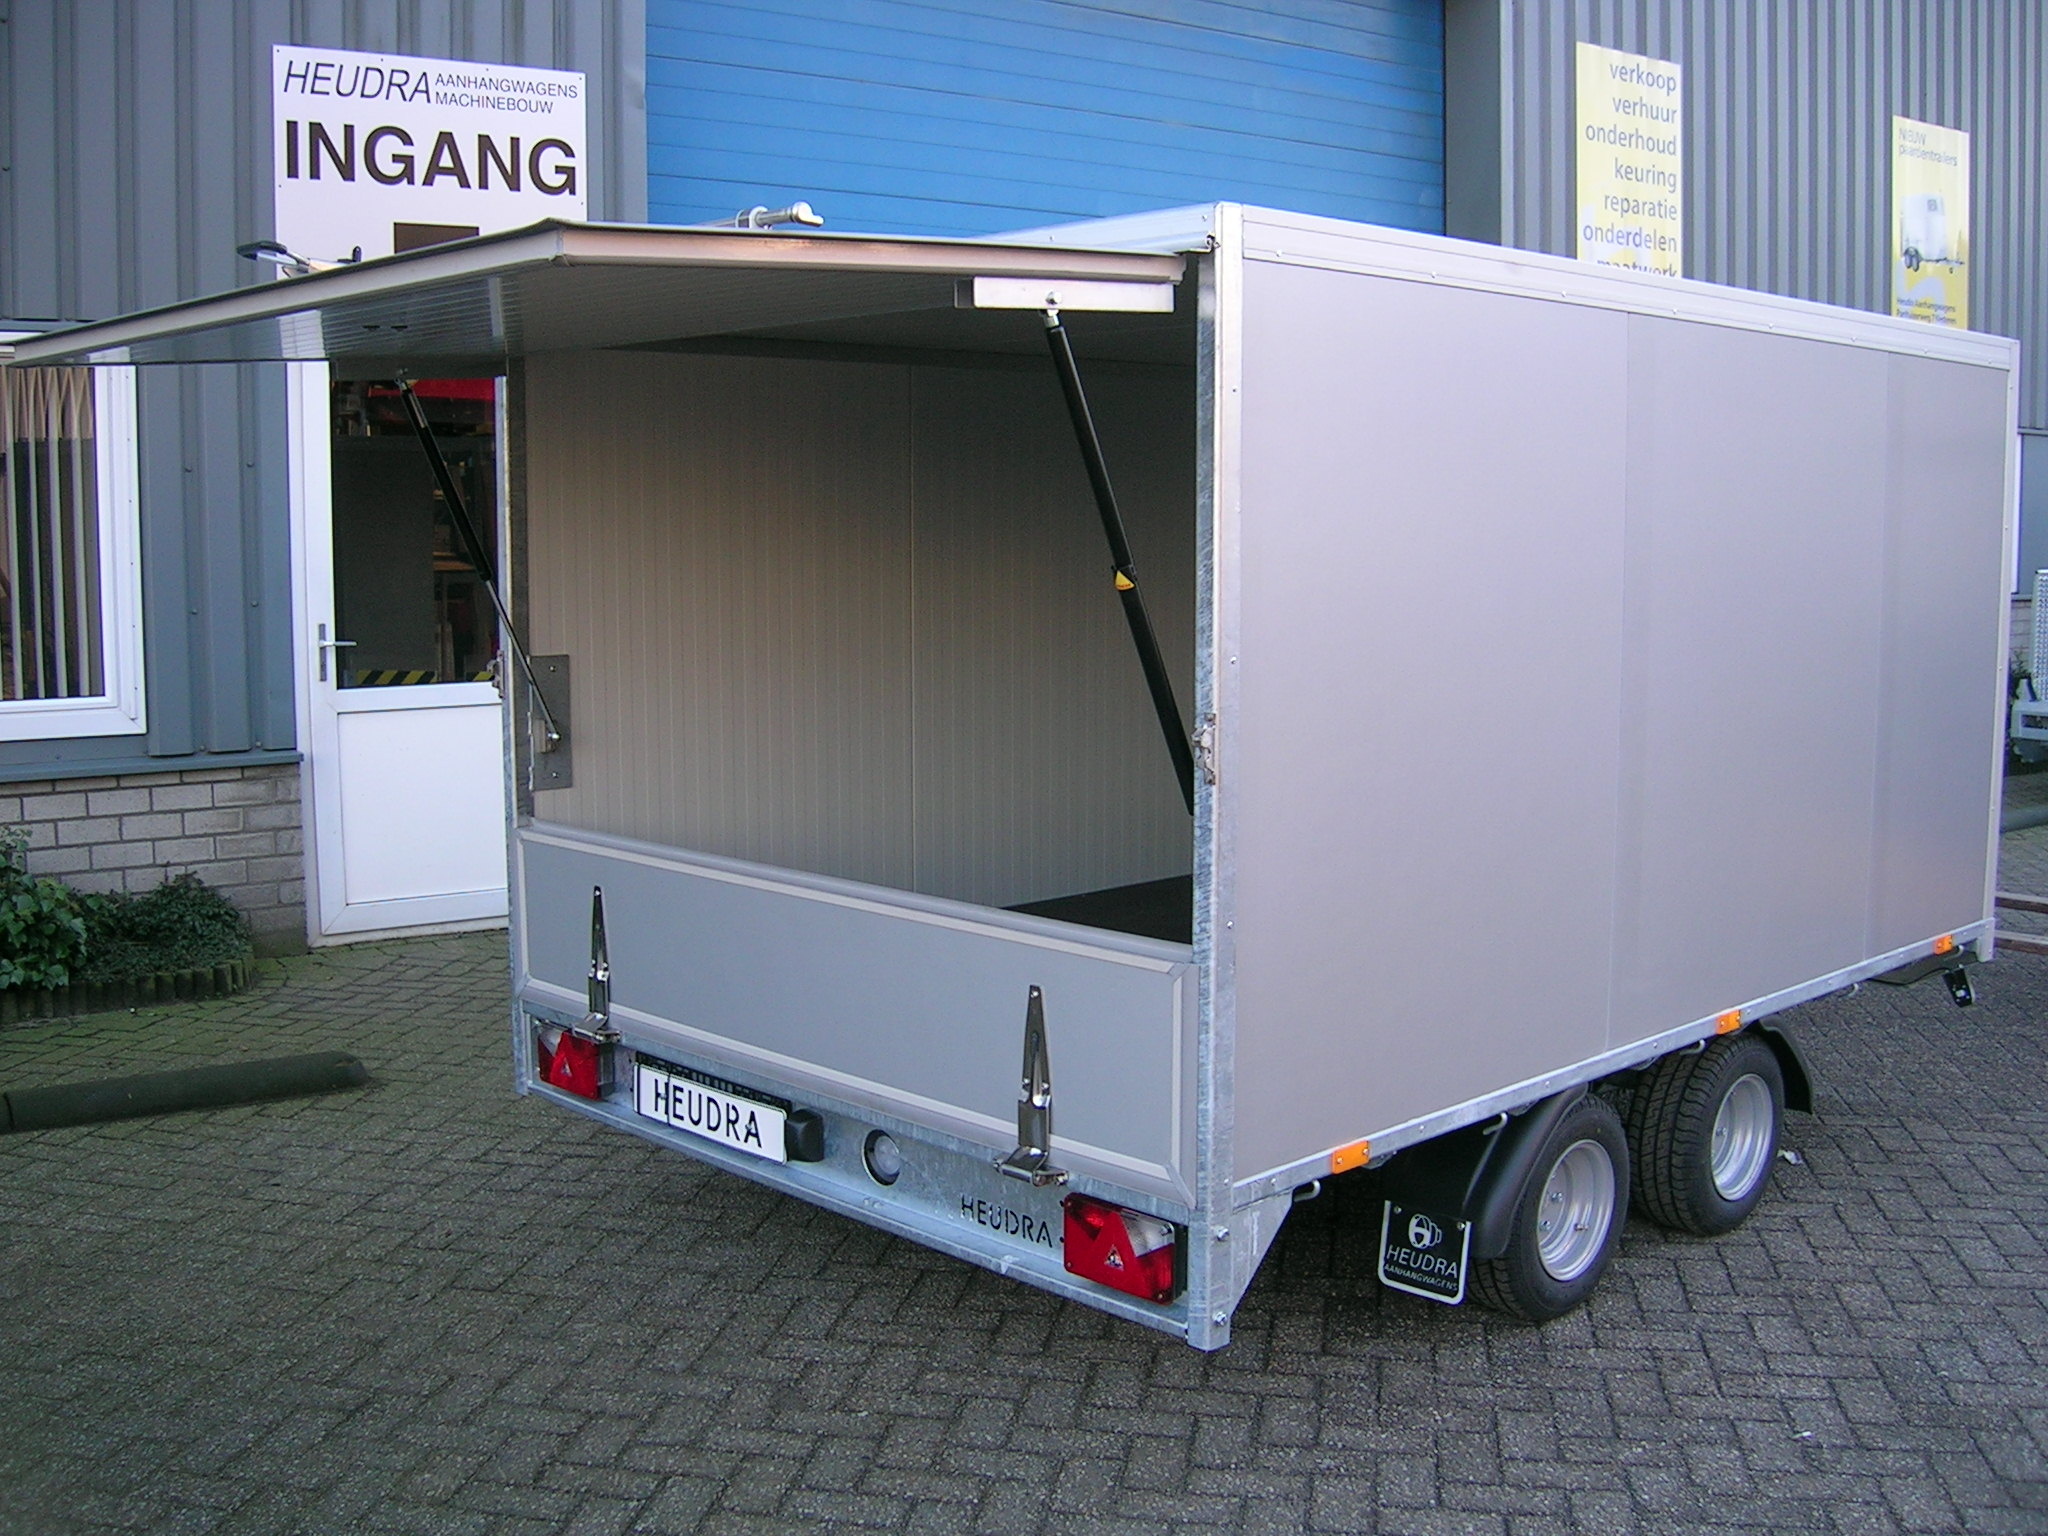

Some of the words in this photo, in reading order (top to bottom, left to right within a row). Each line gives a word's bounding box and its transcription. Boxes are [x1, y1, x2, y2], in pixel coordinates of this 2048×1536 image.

[283, 60, 431, 103] HEUDRA
[435, 72, 579, 99] AANHANGWAGENS
[1609, 62, 1677, 96] verkoop
[435, 91, 554, 114] MACHINEBOUW
[1612, 96, 1678, 124] verhuur
[1585, 124, 1677, 156] onderhoud
[286, 120, 577, 196] INGANG
[1614, 157, 1677, 194] keuring
[1604, 193, 1678, 221] reparatie
[1583, 222, 1677, 253] onderdelen
[654, 1078, 763, 1149] HEUDRA
[961, 1194, 1053, 1248] HEUDRA
[1384, 1263, 1458, 1291] AANHANGWAGENS
[1386, 1244, 1458, 1279] HEUDRA
